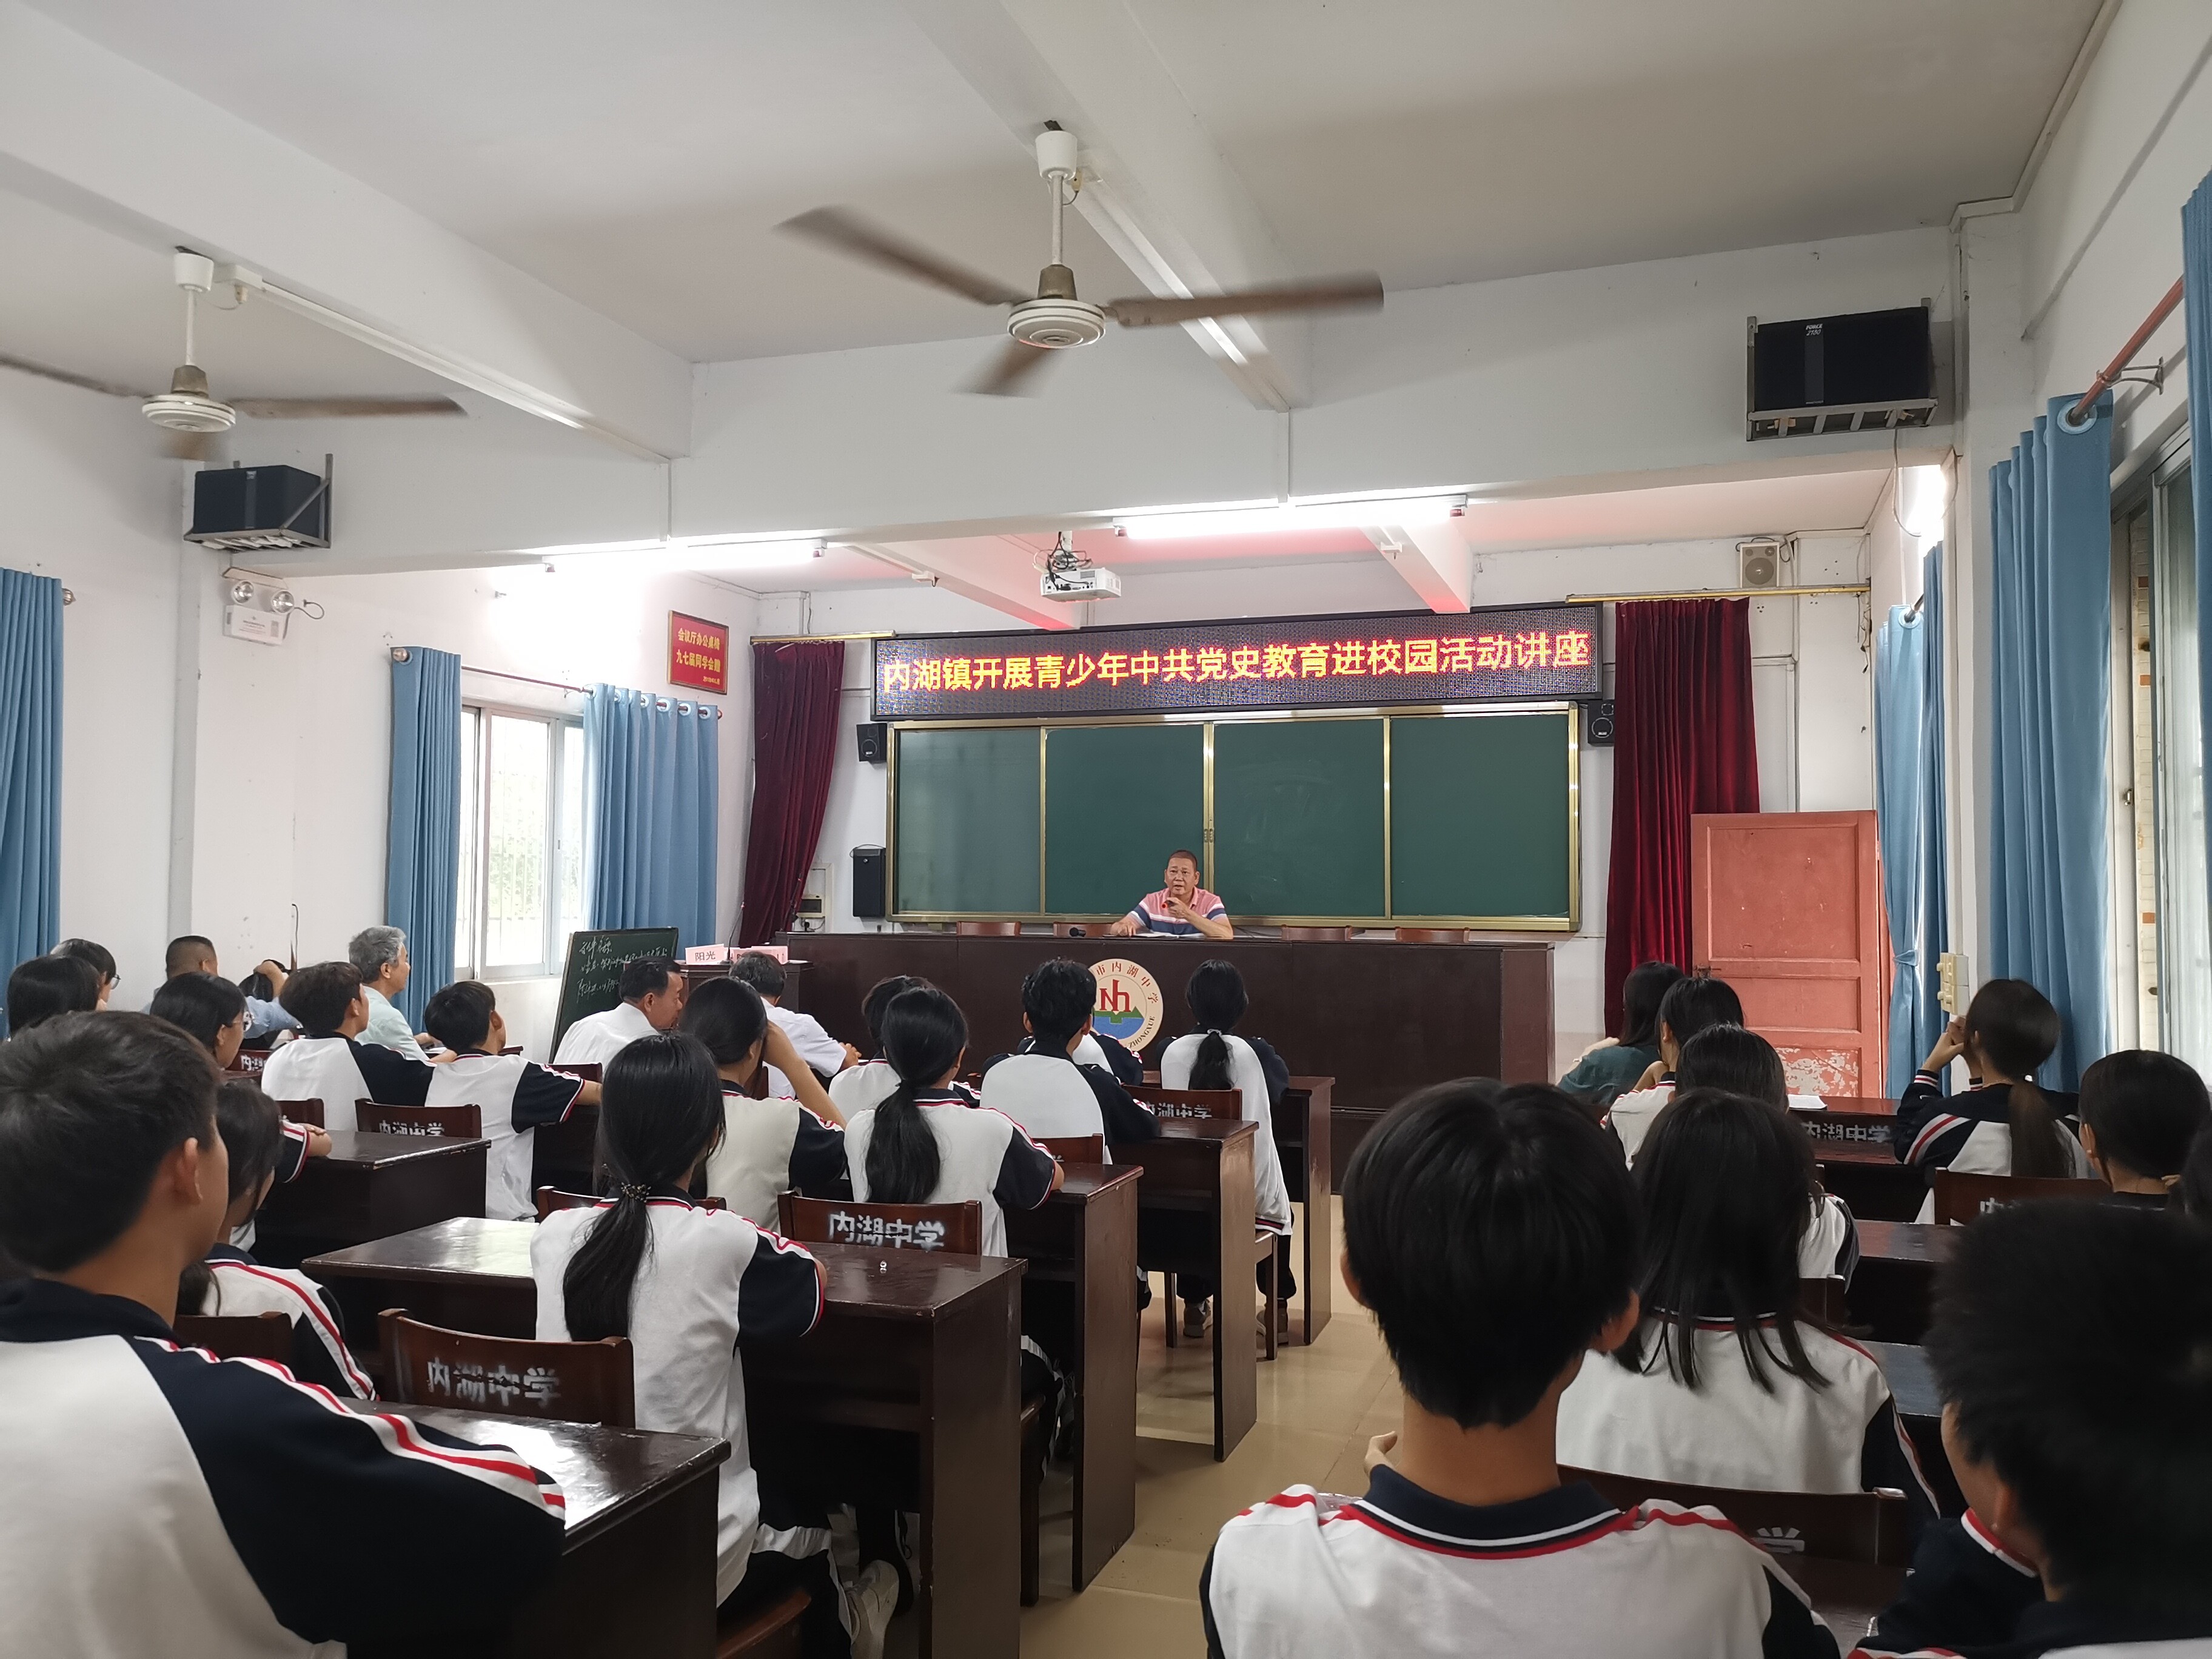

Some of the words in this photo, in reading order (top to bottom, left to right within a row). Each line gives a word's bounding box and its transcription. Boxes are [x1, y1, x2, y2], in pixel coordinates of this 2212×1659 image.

[883, 630, 1589, 692] 内湖镇开展青少年中共党史教育进校园活动讲座
[695, 951, 716, 962] 阳光
[1128, 1016, 1155, 1048] ZHONGXUE
[828, 1211, 945, 1249] 内湖中学
[427, 1357, 560, 1407] 内湖中学
